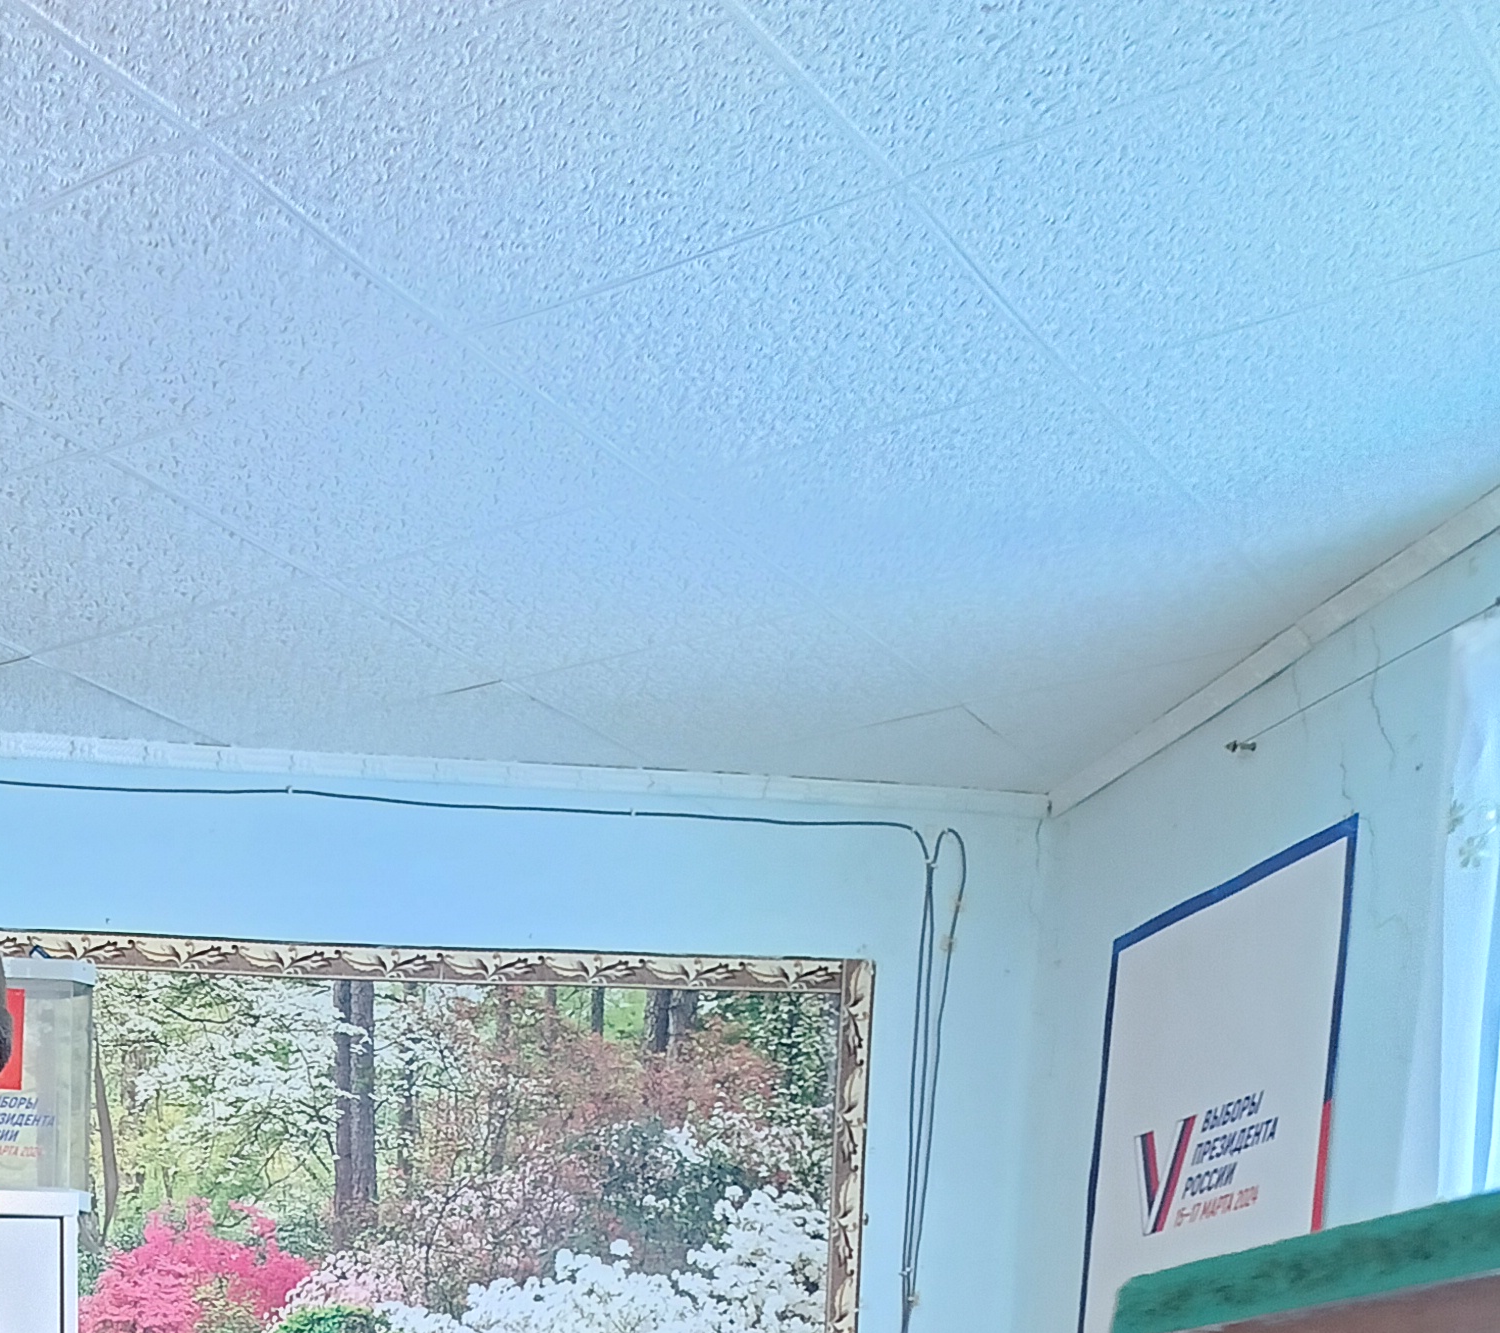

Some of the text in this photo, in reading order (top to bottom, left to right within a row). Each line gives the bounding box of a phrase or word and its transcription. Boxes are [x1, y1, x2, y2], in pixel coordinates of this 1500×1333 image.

[1201, 1089, 1264, 1133] ВЫБОРЫ
[1191, 1116, 1279, 1166] ПРЕЗИДЕНТА
[1181, 1161, 1238, 1199] РОССИИ
